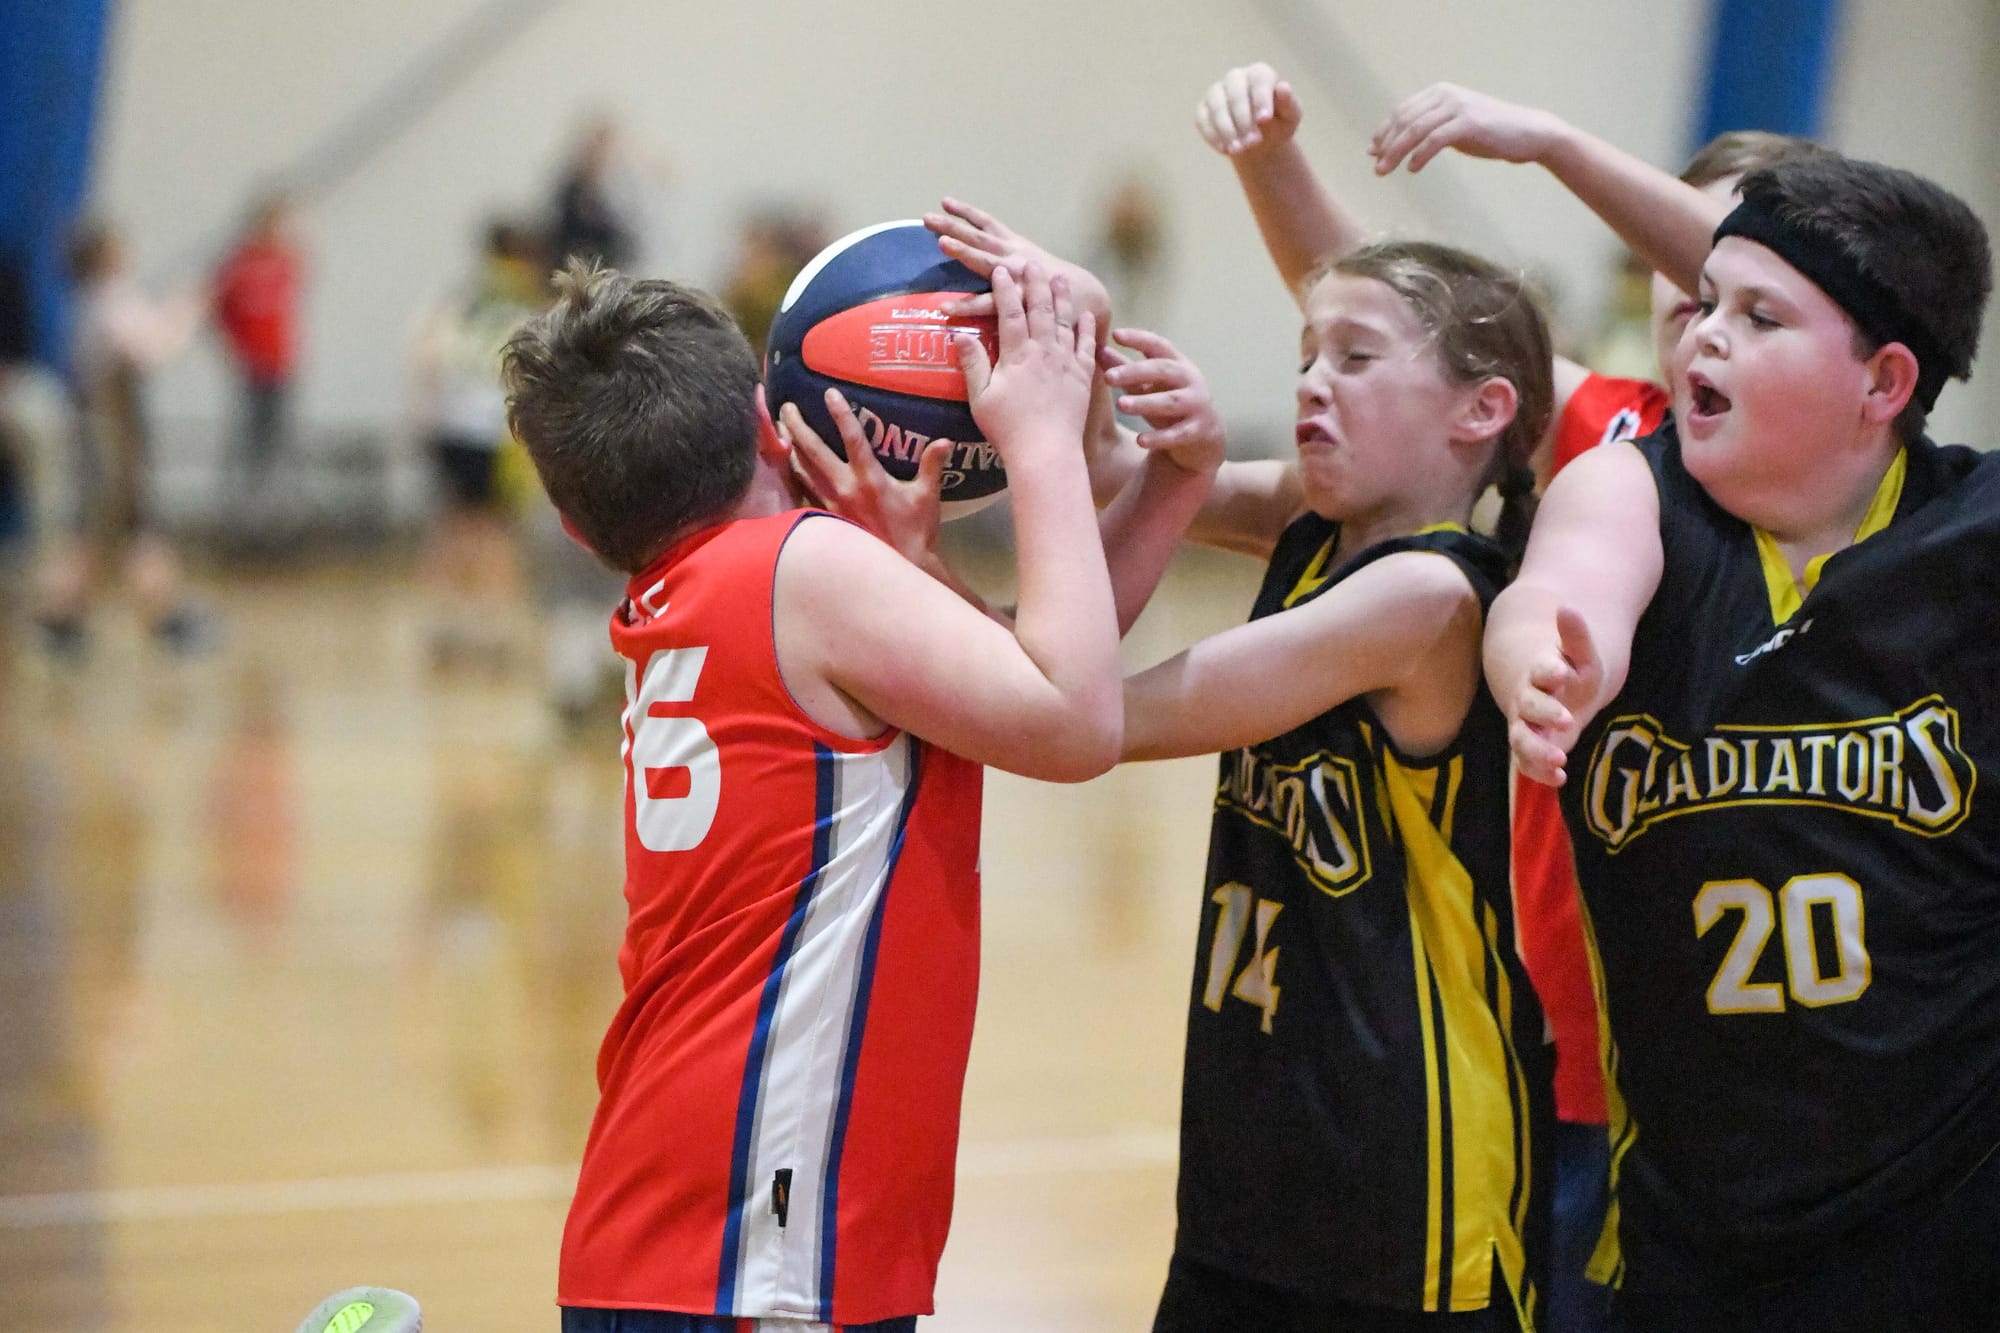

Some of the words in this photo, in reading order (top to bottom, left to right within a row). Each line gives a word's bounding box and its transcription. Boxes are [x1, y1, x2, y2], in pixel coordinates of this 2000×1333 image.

[1590, 705, 1961, 845] GLADIATORS
[1203, 880, 1285, 1036] 14
[1692, 871, 1872, 1015] 20
